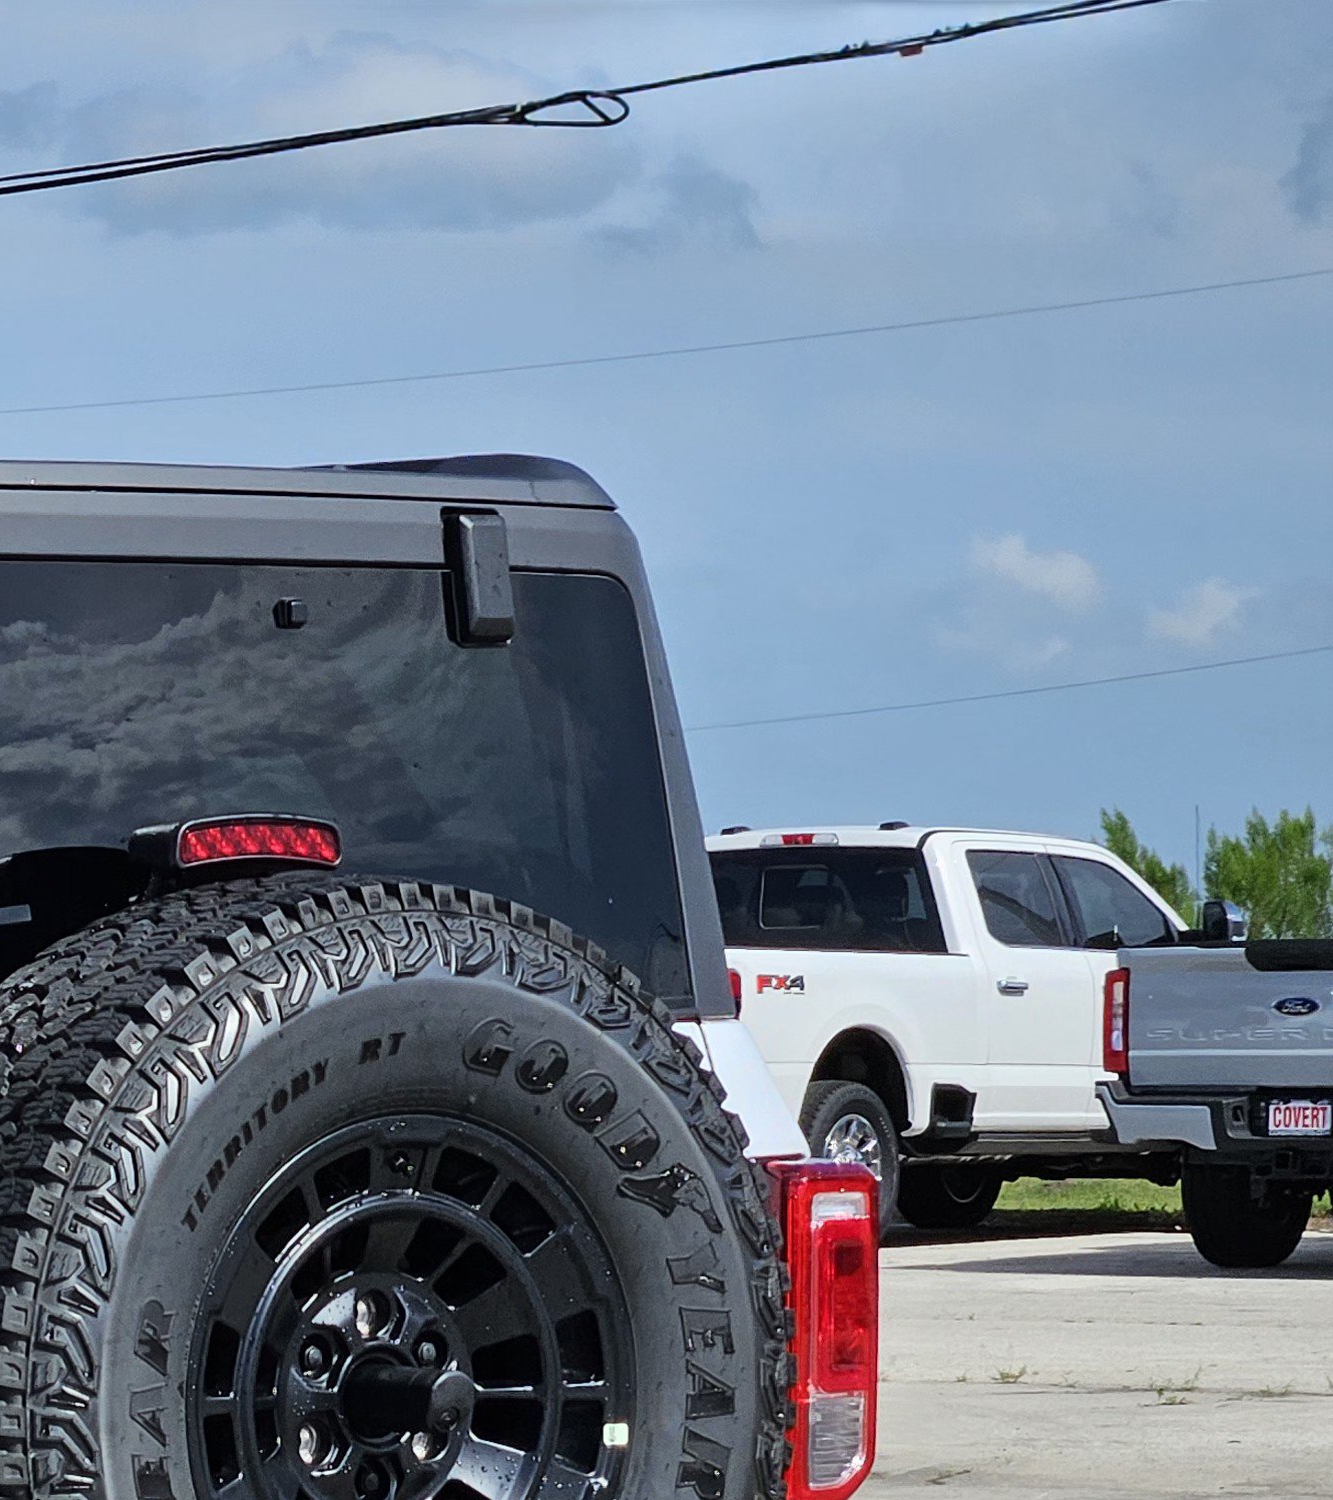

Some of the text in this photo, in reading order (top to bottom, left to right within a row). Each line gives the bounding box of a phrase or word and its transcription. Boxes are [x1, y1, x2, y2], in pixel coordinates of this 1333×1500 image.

[757, 975, 805, 994] FX4
[1146, 1027, 1310, 1042] SUPER
[1273, 1105, 1329, 1129] COVERT
[181, 1032, 407, 1232] TERRITORY RT
